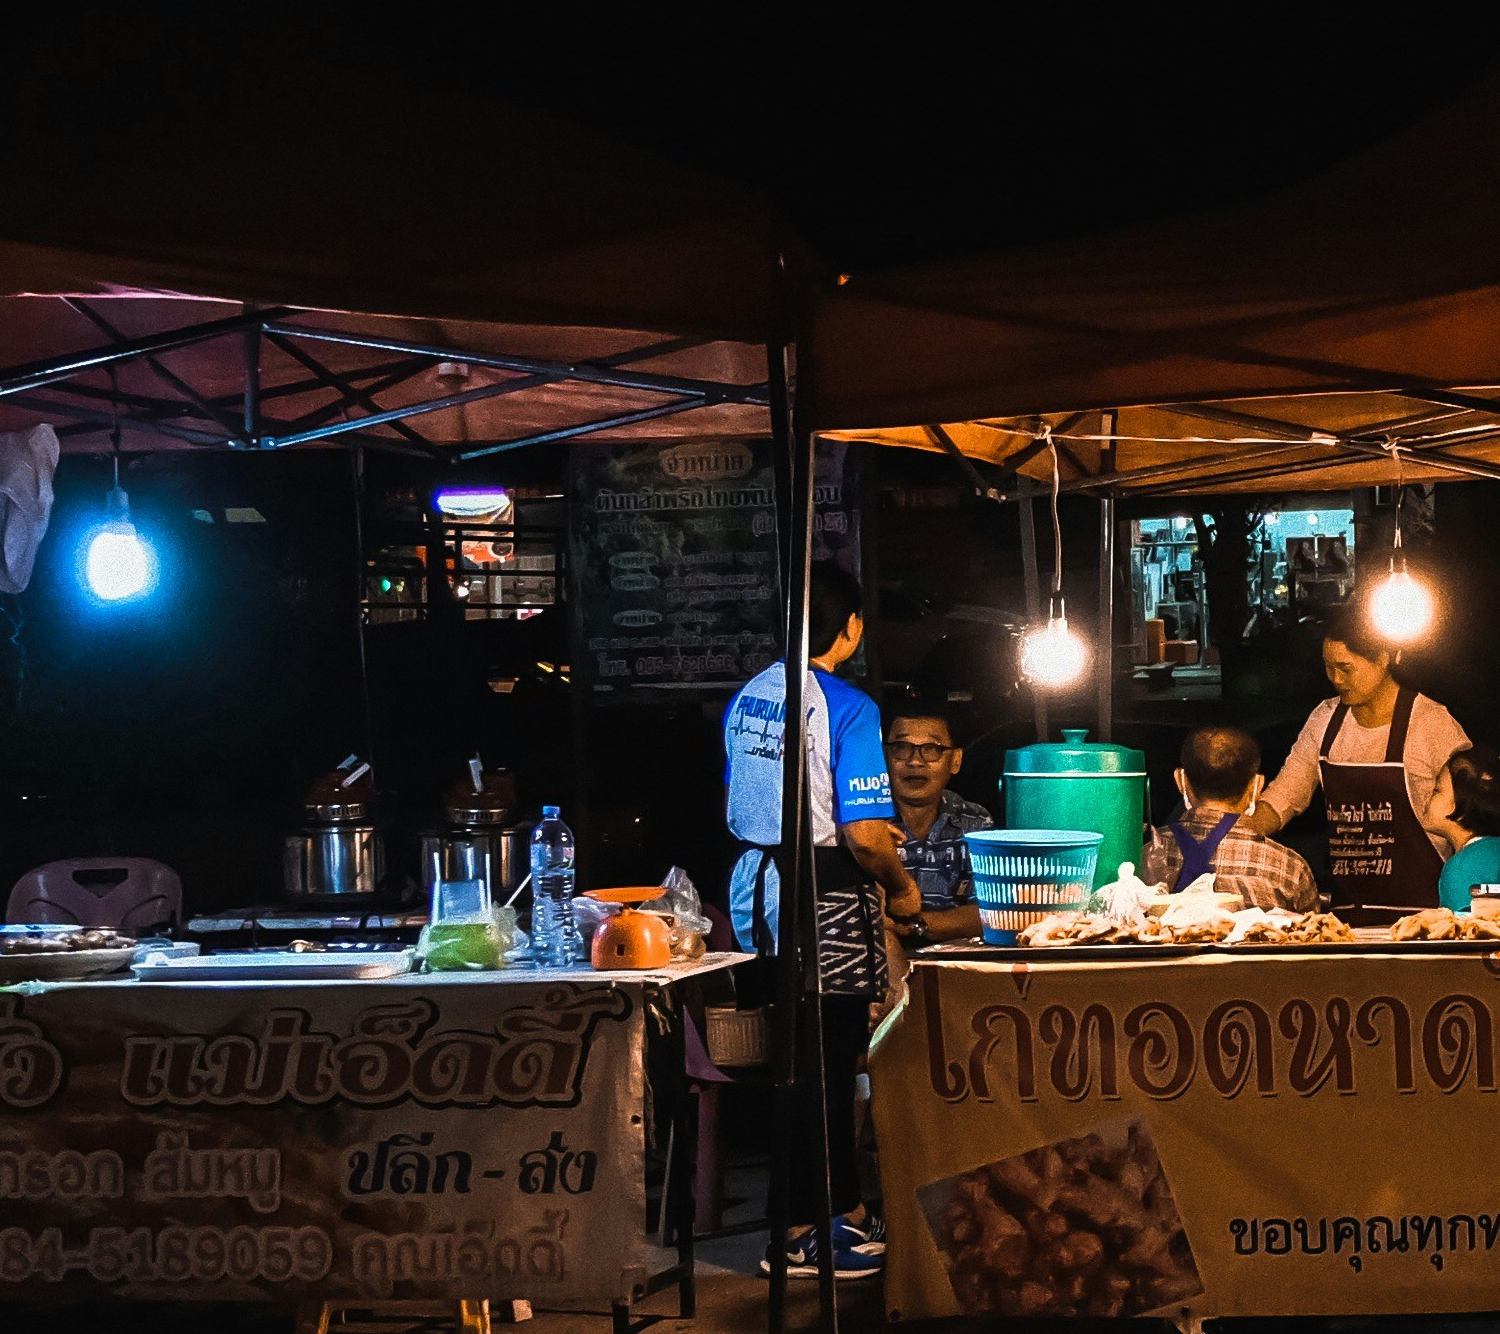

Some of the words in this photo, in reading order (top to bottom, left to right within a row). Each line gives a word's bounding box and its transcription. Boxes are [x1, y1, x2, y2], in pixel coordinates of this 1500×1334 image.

[122, 981, 628, 1106] แม่เอ็ดดี้
[348, 1132, 472, 1194] ปลีก
[519, 1132, 597, 1194] ส่ง
